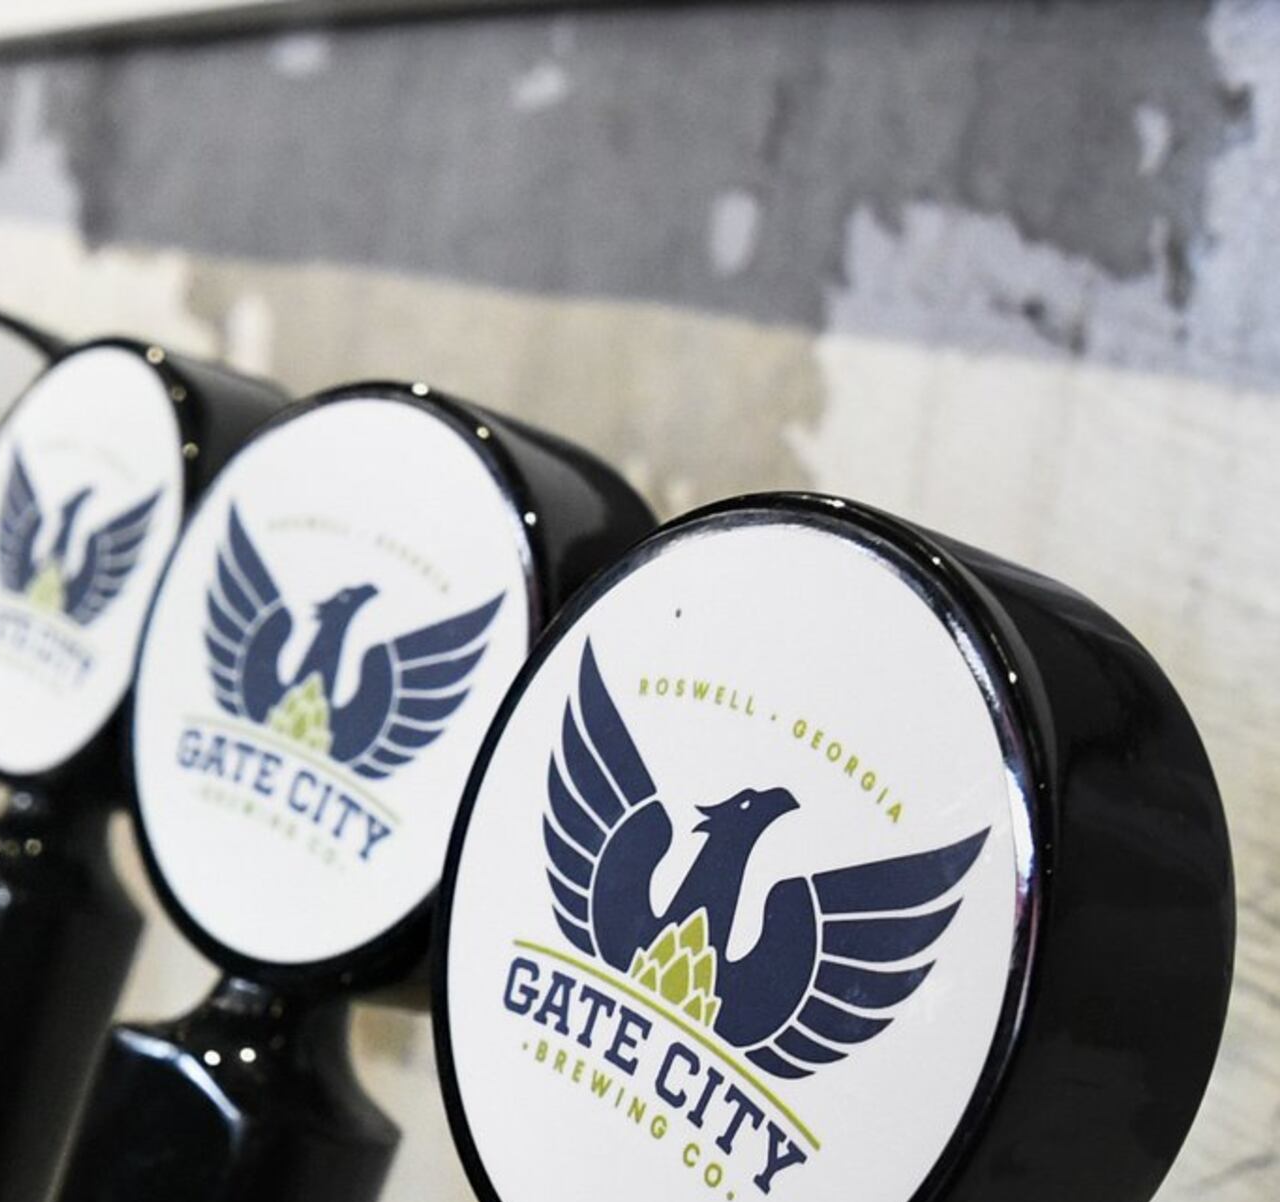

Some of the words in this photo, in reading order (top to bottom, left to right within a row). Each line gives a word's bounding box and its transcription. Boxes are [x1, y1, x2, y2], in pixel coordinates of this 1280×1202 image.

[176, 728, 283, 797] GATE
[288, 769, 392, 860] CITY
[638, 678, 755, 716] ROSWELL
[792, 719, 903, 824] GEORGIA
[503, 956, 653, 1077] GATE
[655, 1041, 808, 1196] CITY
[534, 1040, 668, 1140] BREWING
